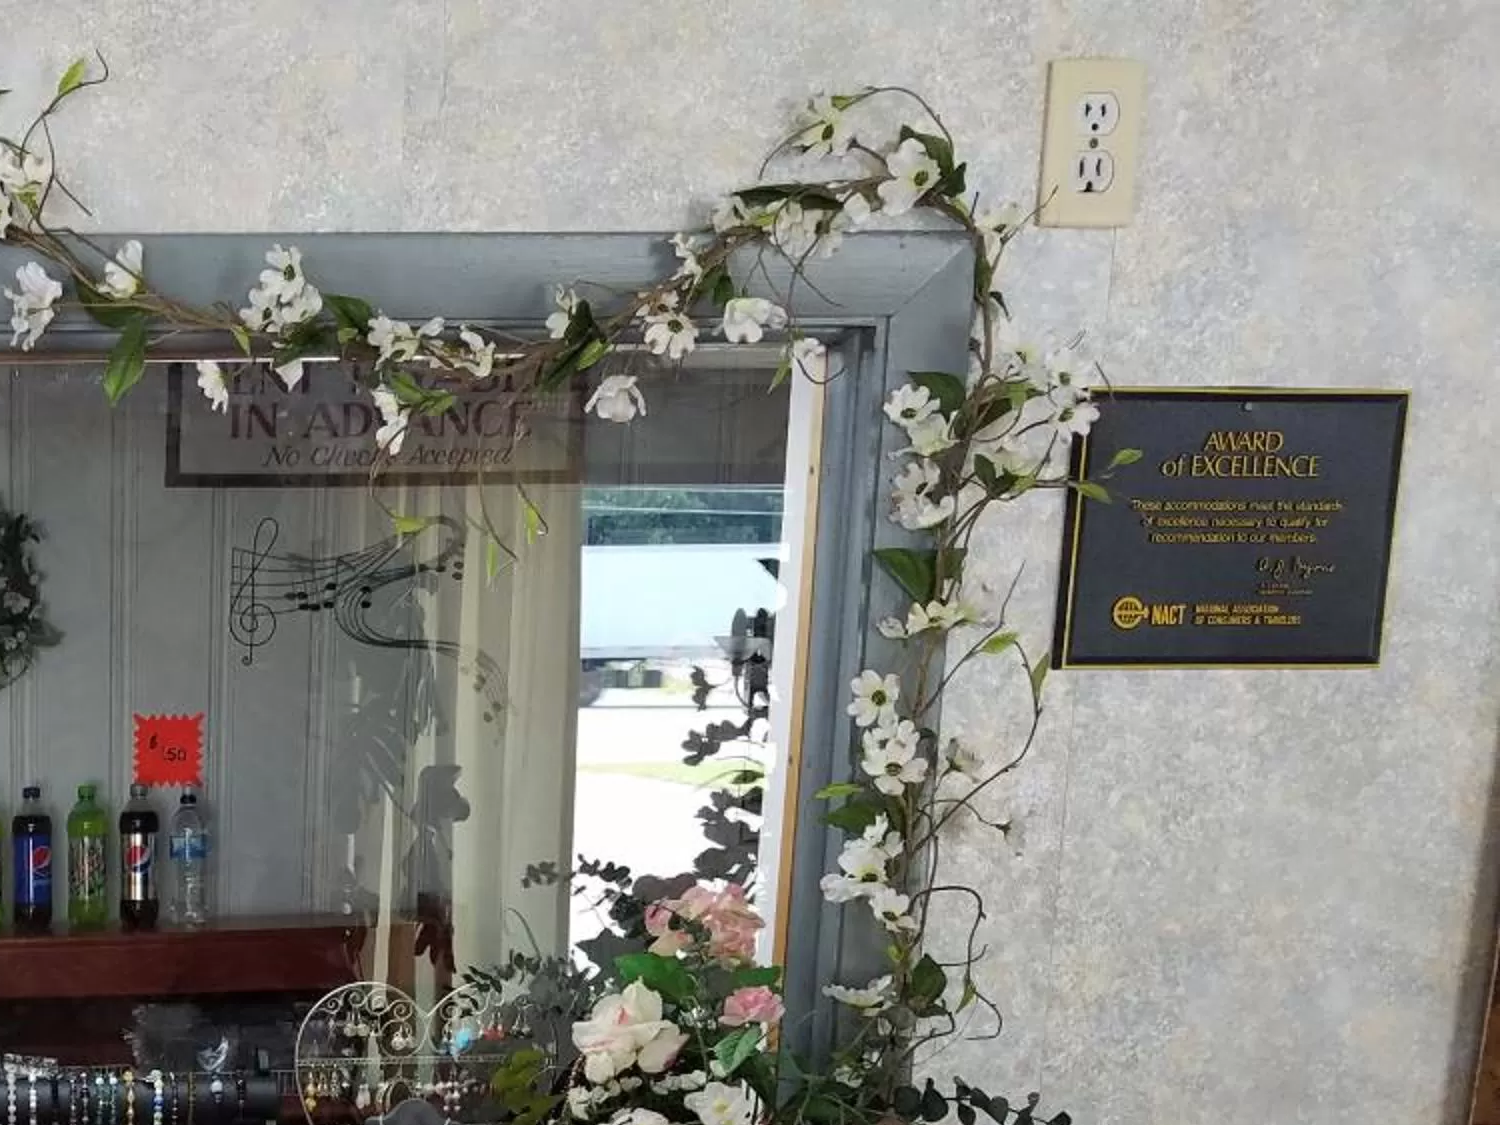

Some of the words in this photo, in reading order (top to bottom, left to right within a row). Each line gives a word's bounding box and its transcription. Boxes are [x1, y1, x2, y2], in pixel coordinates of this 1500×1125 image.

[231, 402, 278, 438] IN
[303, 402, 532, 438] ADANCE
[1203, 431, 1284, 452] AWARD
[261, 444, 300, 466] No
[1161, 455, 1184, 478] of
[1191, 455, 1323, 478] EXCELLENCE
[1151, 604, 1188, 625] NACT
